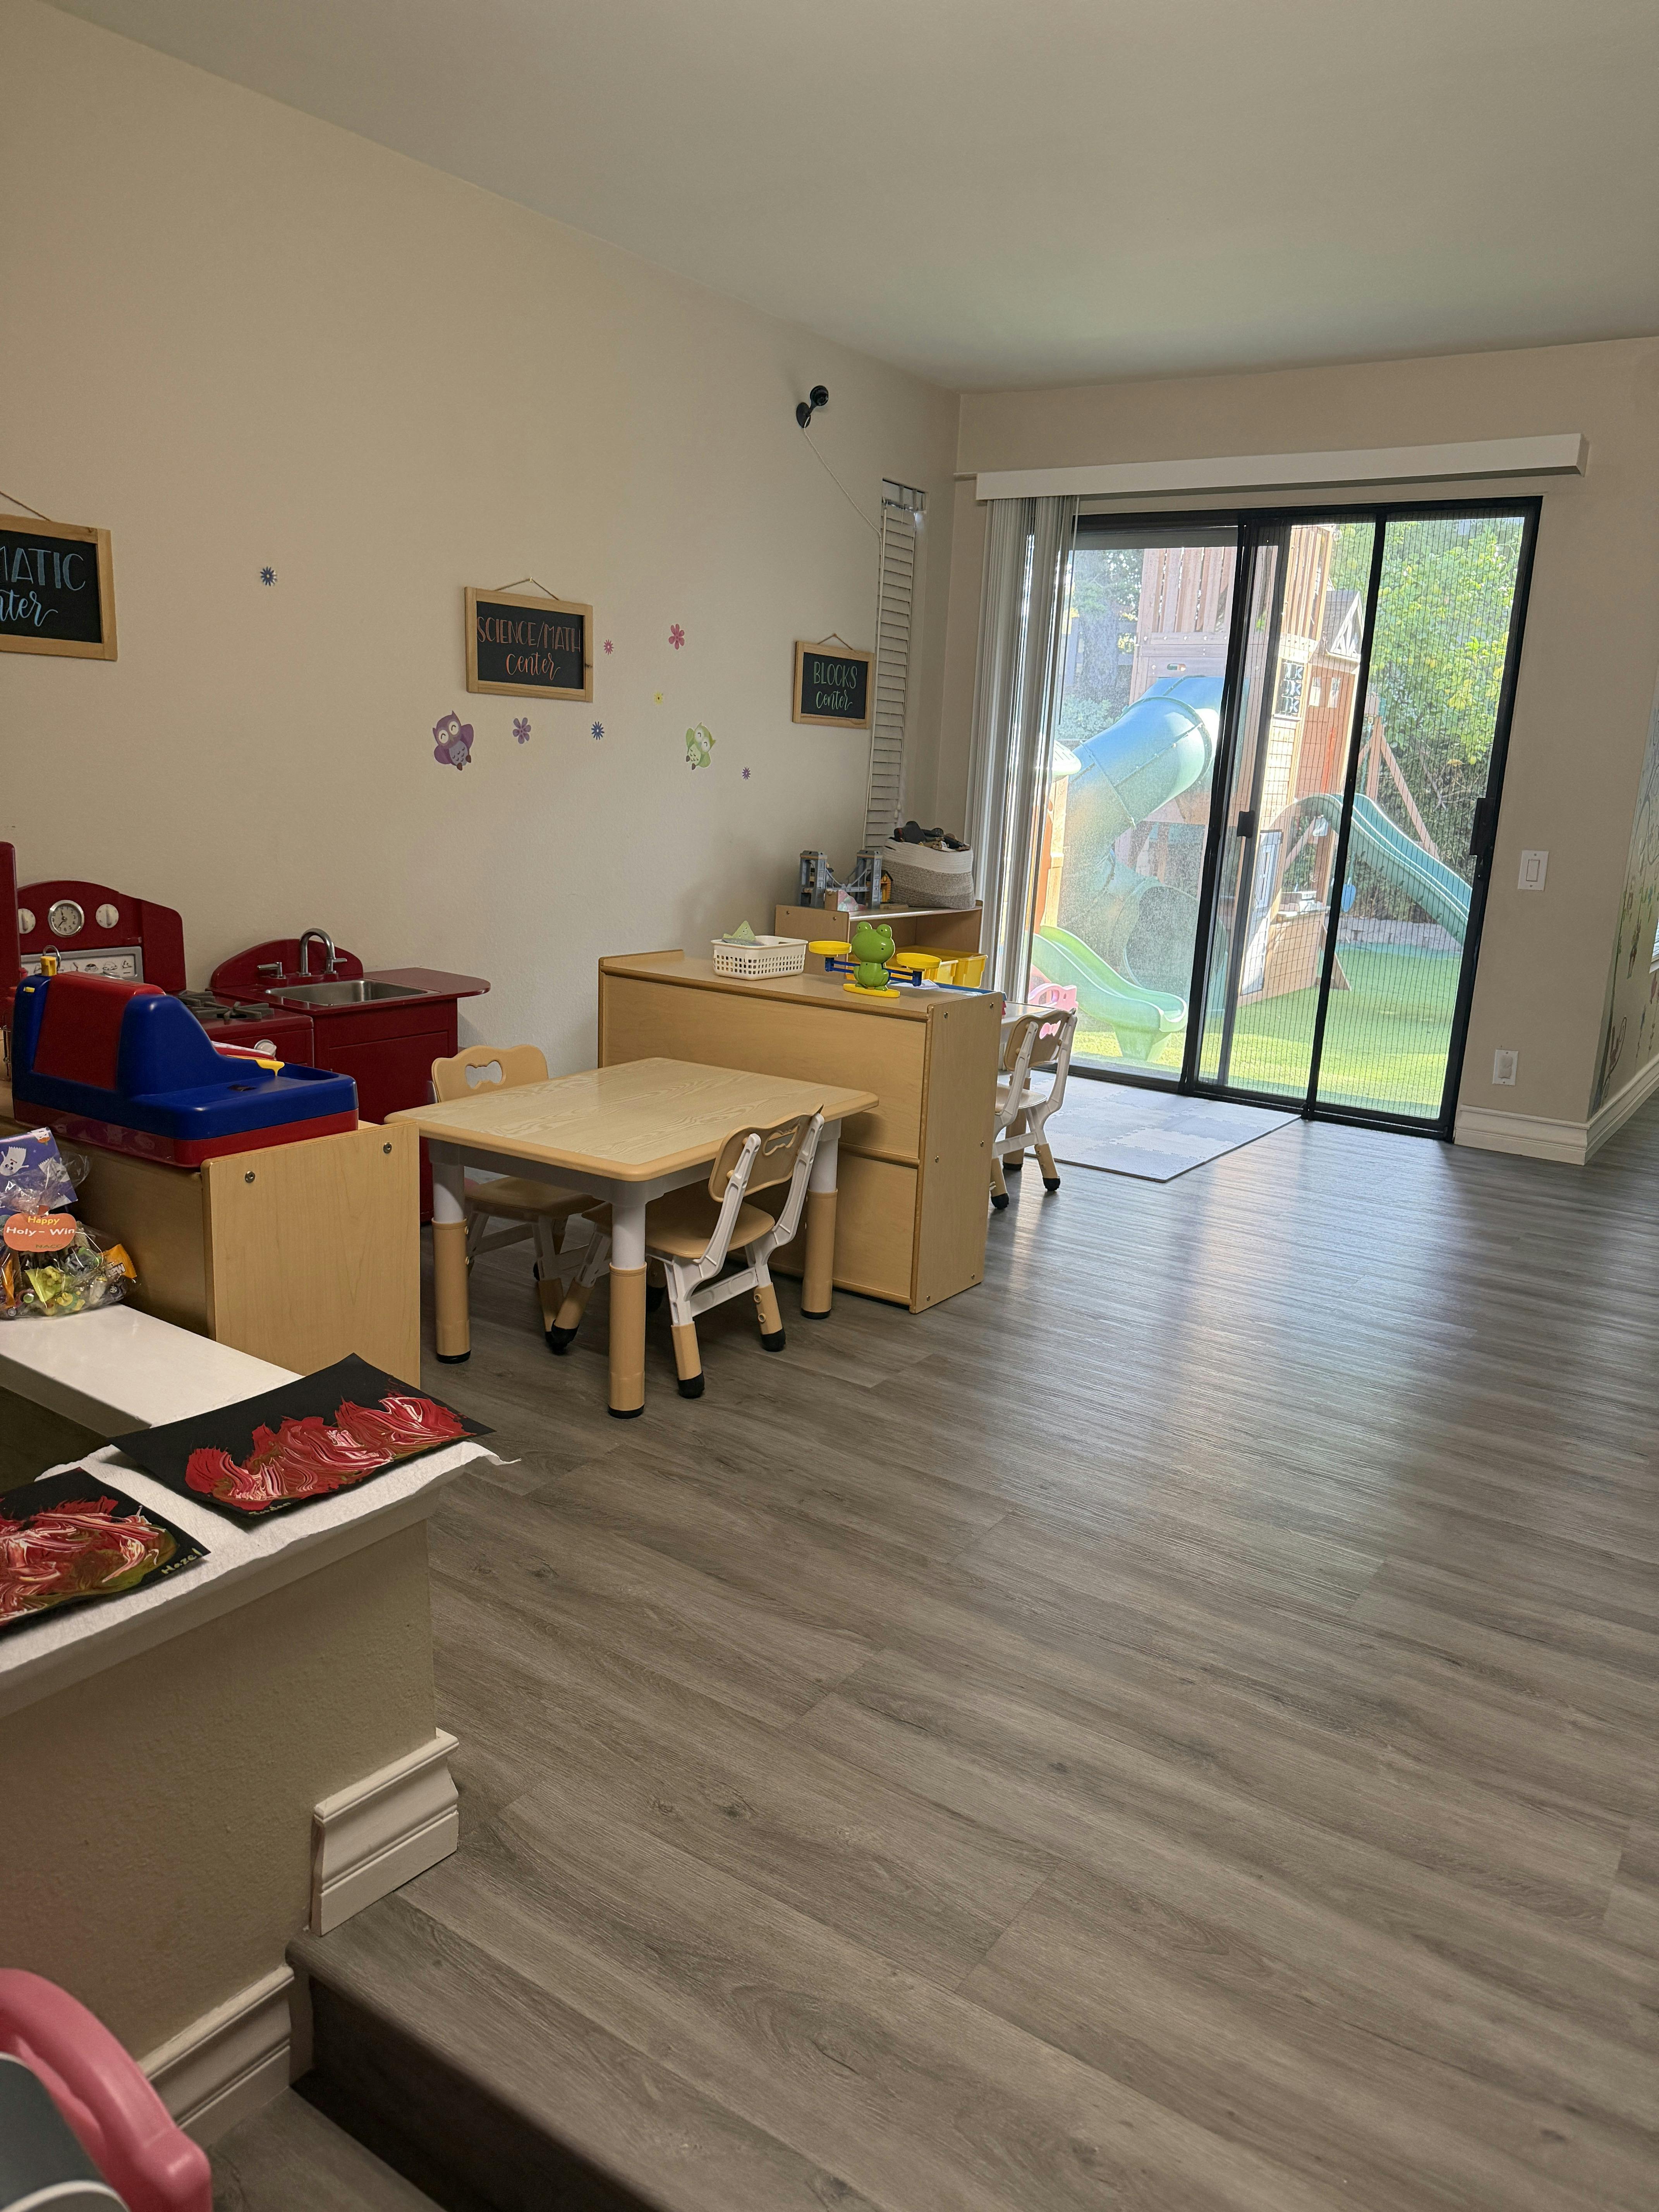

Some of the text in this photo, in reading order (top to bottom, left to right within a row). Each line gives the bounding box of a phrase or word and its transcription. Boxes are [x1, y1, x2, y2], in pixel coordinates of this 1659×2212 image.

[477, 617, 580, 652] SCIENCE/MATH
[814, 661, 857, 689] BLOCKS
[27, 1216, 60, 1225] Happy
[161, 1548, 203, 1574] Hazel
